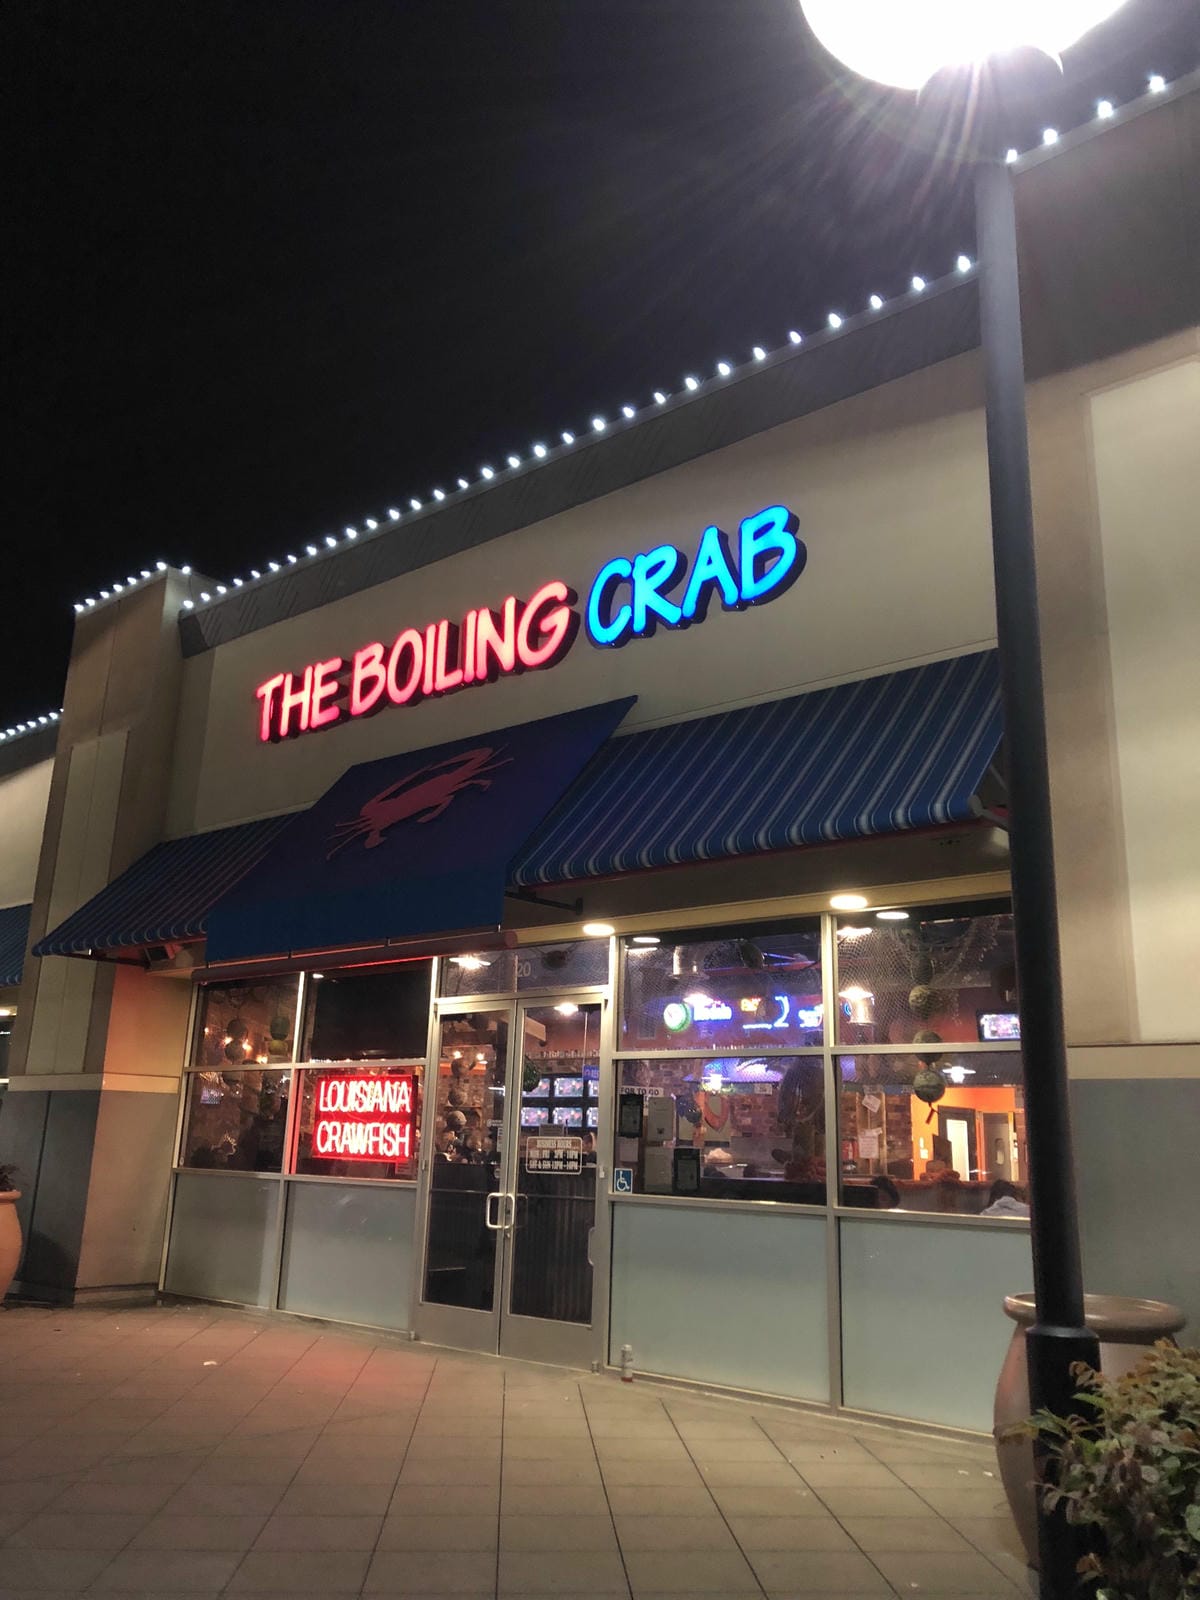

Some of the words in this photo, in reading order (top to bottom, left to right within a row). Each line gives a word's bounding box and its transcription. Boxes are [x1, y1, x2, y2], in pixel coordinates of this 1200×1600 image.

[256, 657, 343, 742] THE
[350, 580, 571, 716] BOILING
[587, 505, 799, 645] CRAB
[319, 1080, 411, 1113] LOUISIANA
[316, 1120, 410, 1157] CRAWFISH
